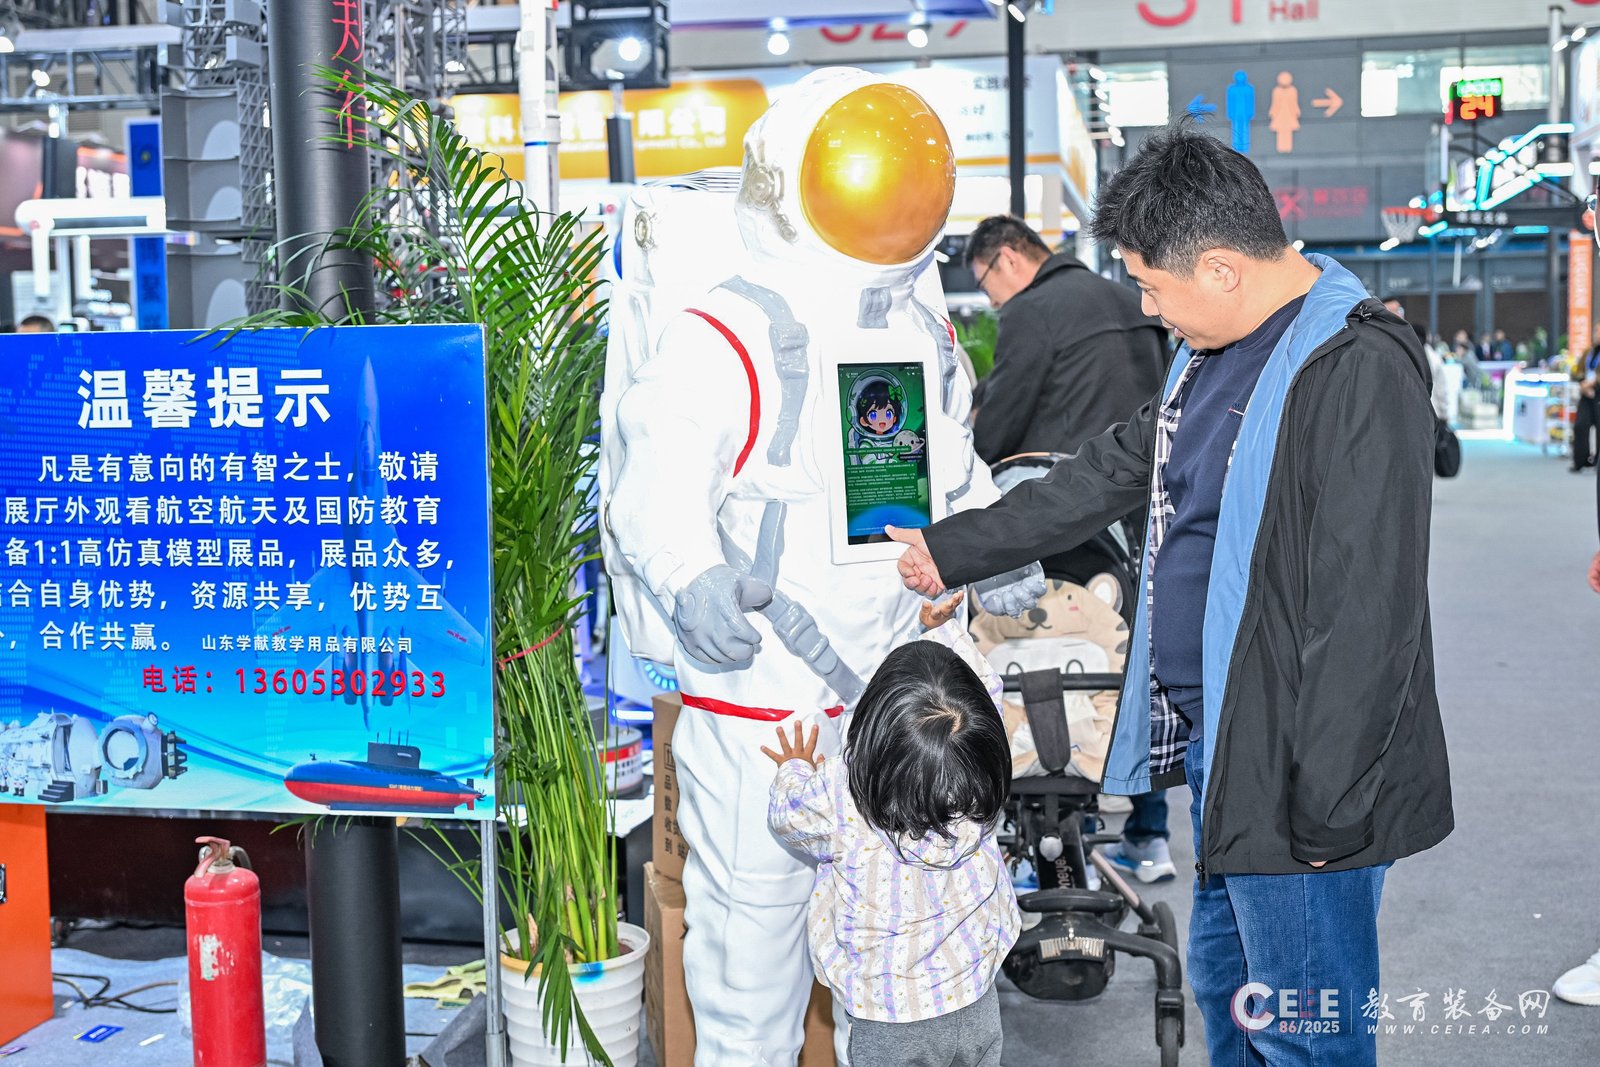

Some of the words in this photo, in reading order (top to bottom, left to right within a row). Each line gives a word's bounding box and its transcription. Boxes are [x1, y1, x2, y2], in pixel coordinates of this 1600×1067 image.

[1459, 95, 1495, 120] 24
[77, 367, 331, 430] 温馨提示
[38, 451, 439, 484] 凡是有意向的有智之士，敬请
[4, 496, 442, 526] 展厅外观看航空航天及国防教育
[0, 578, 443, 613] 合自身优势，资源共享，优势互
[202, 634, 413, 655] 山东学献教学用品有限公司
